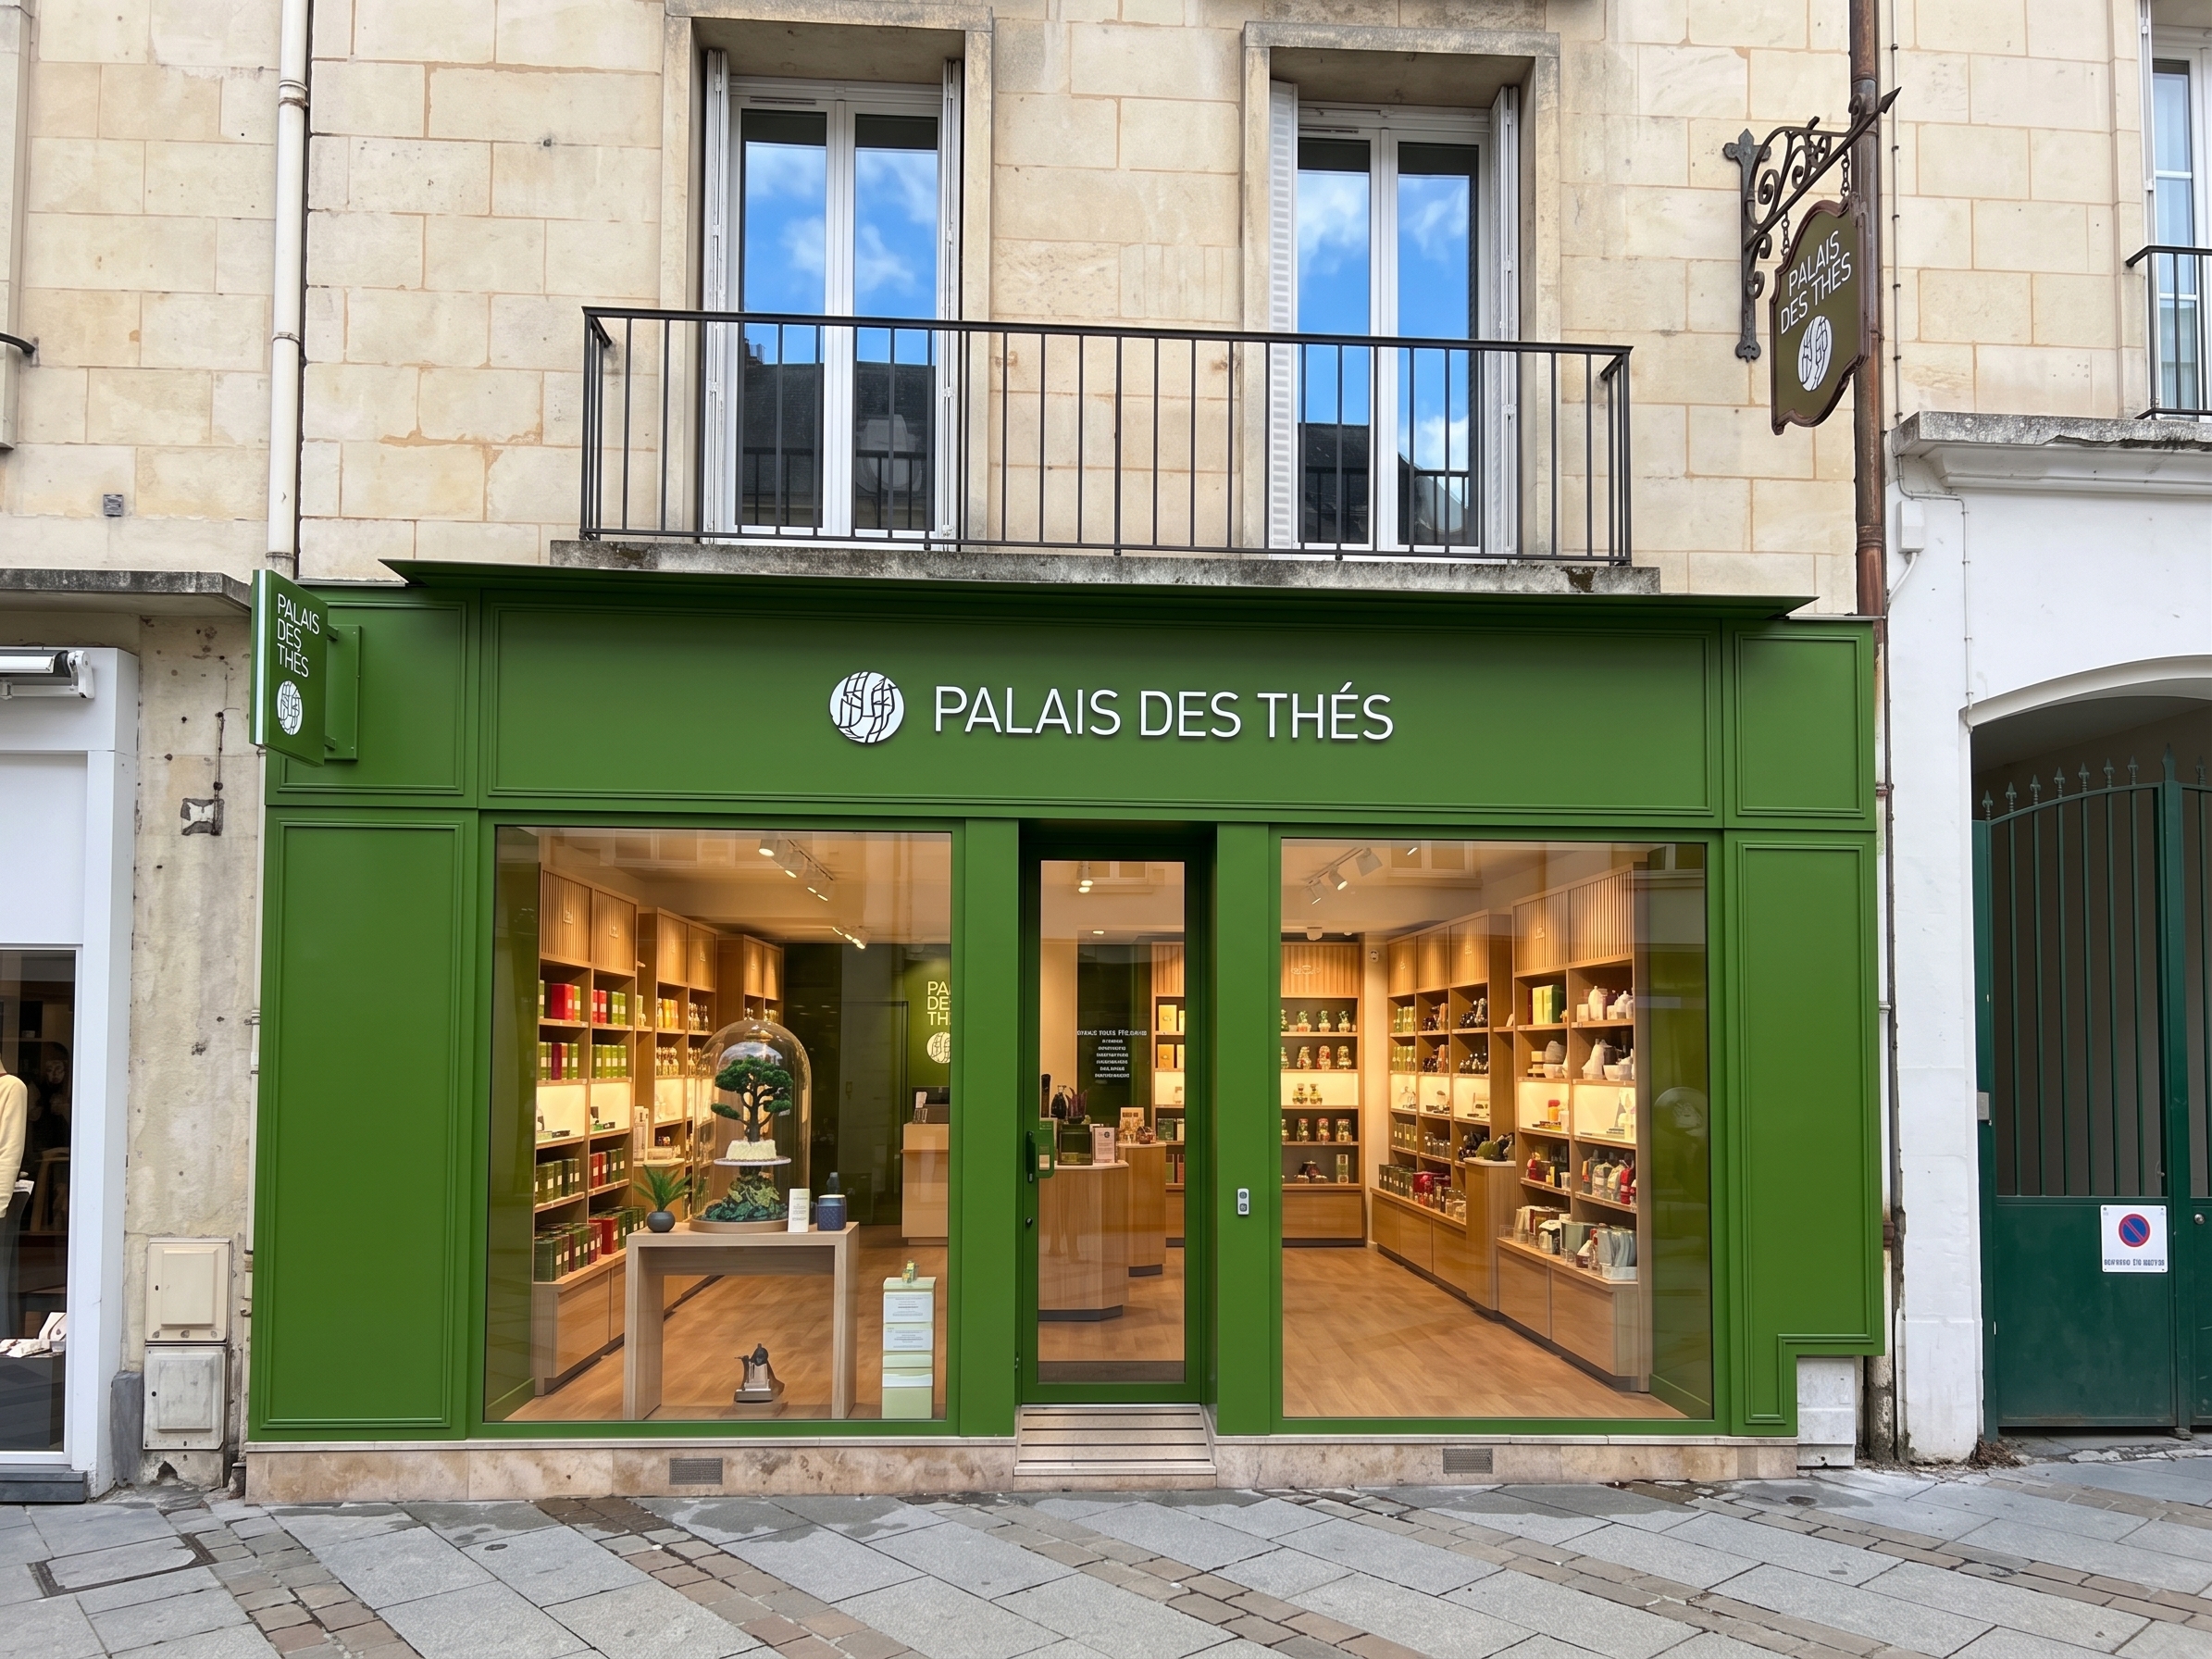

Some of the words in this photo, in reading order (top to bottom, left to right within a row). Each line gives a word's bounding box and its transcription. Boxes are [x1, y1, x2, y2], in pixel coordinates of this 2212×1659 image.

[1789, 230, 1840, 297] PALAIS
[1781, 290, 1808, 335] DES
[278, 592, 320, 635] PALAIS
[277, 617, 302, 653] DES
[277, 642, 309, 678] THÉS
[935, 685, 1121, 736] PALAIS
[1140, 690, 1241, 738] DES
[1257, 681, 1394, 741] THÉS
[926, 995, 951, 1011] DE
[927, 980, 951, 996] PA
[926, 1011, 951, 1026] TH
